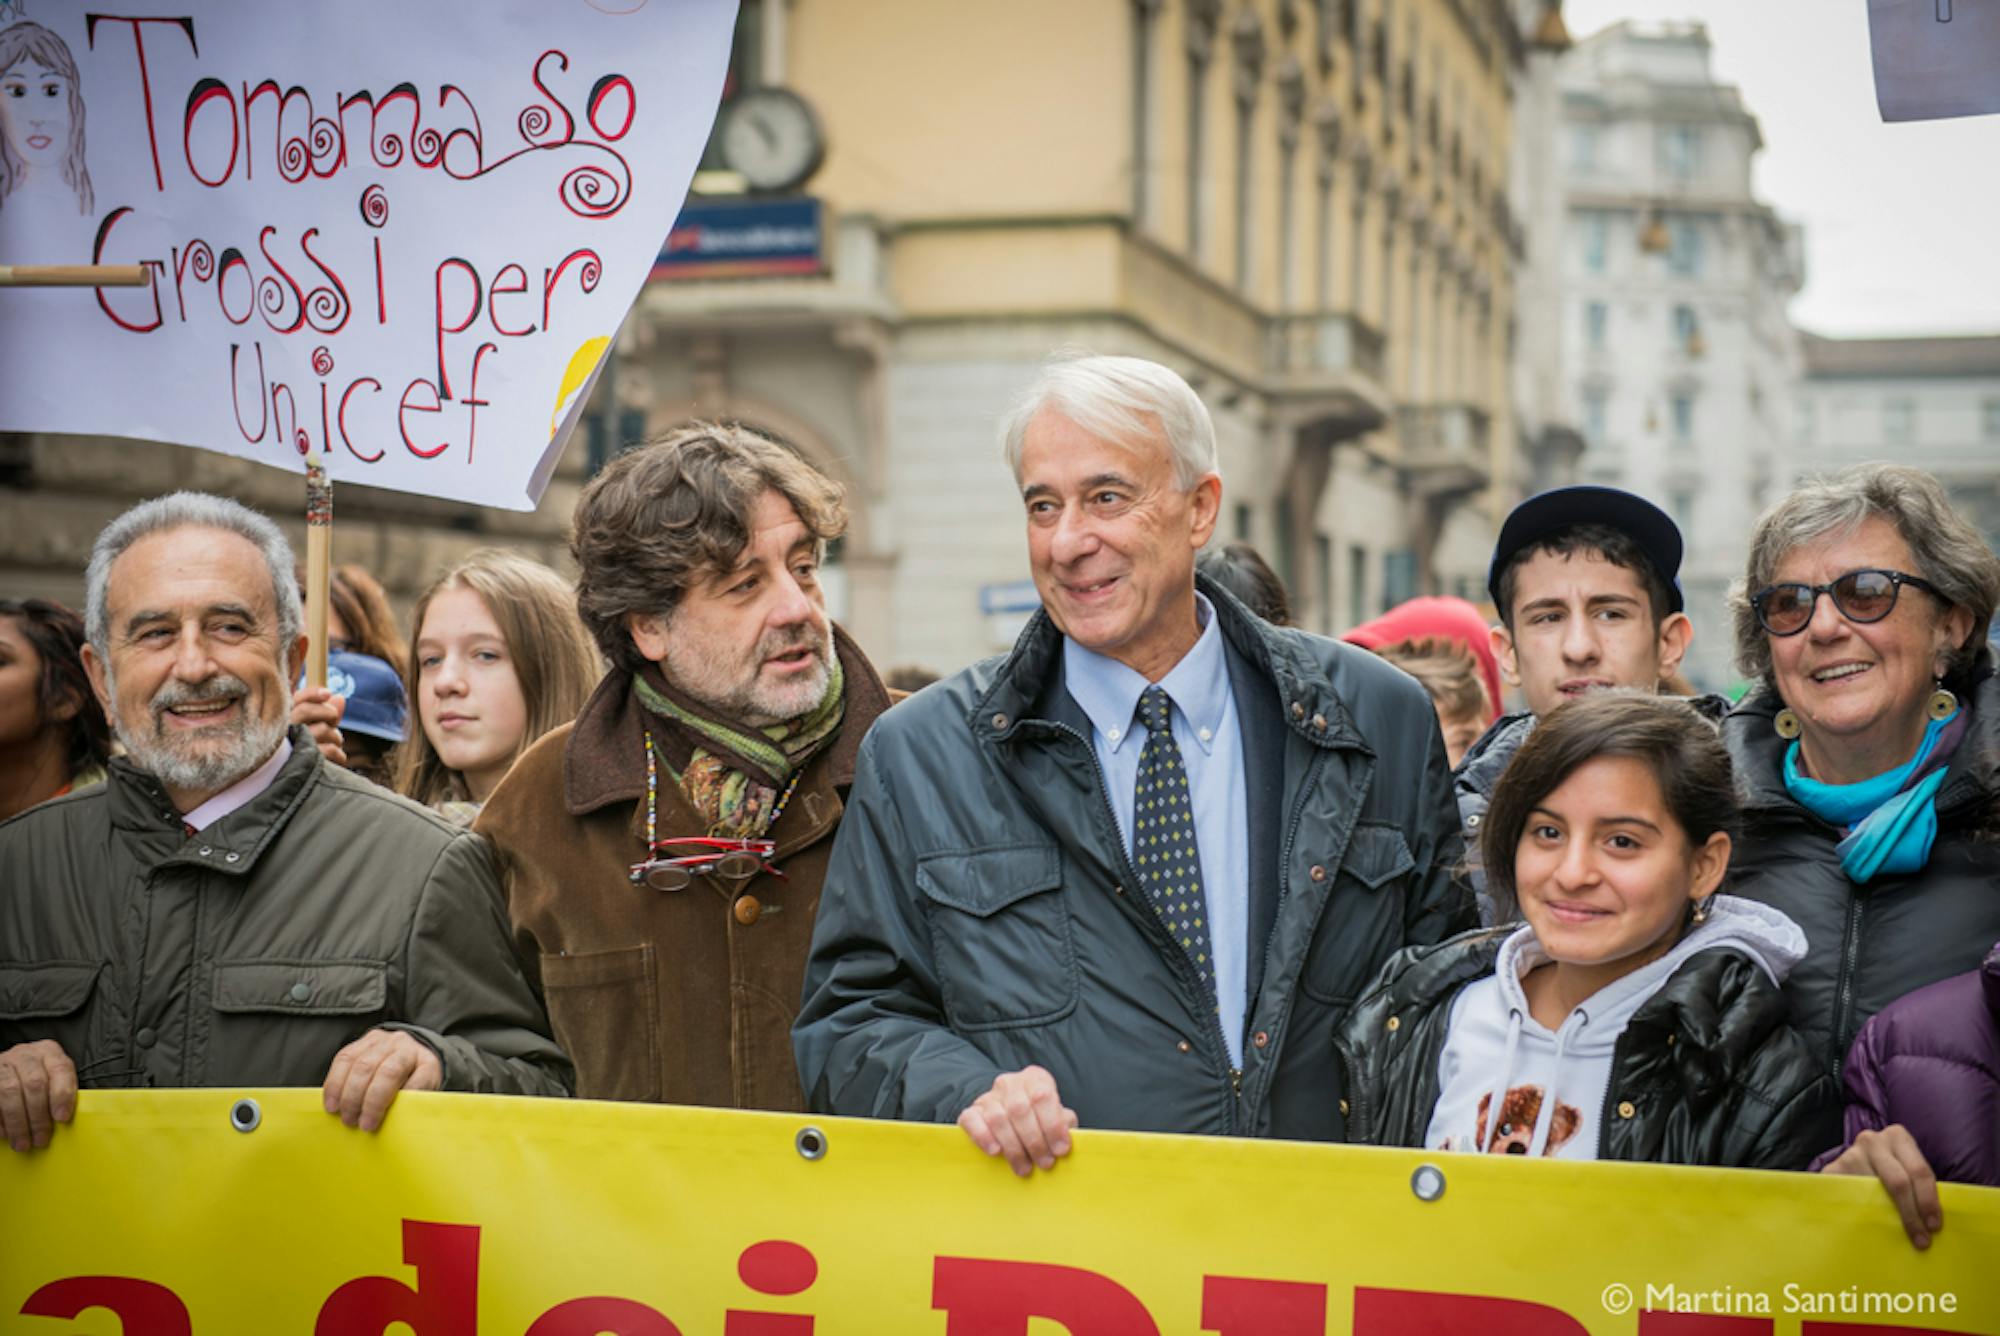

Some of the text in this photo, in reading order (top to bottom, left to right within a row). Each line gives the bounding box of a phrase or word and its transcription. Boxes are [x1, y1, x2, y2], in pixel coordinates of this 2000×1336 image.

[92, 184, 603, 400] Grossi per
[230, 341, 499, 465] Unicef
